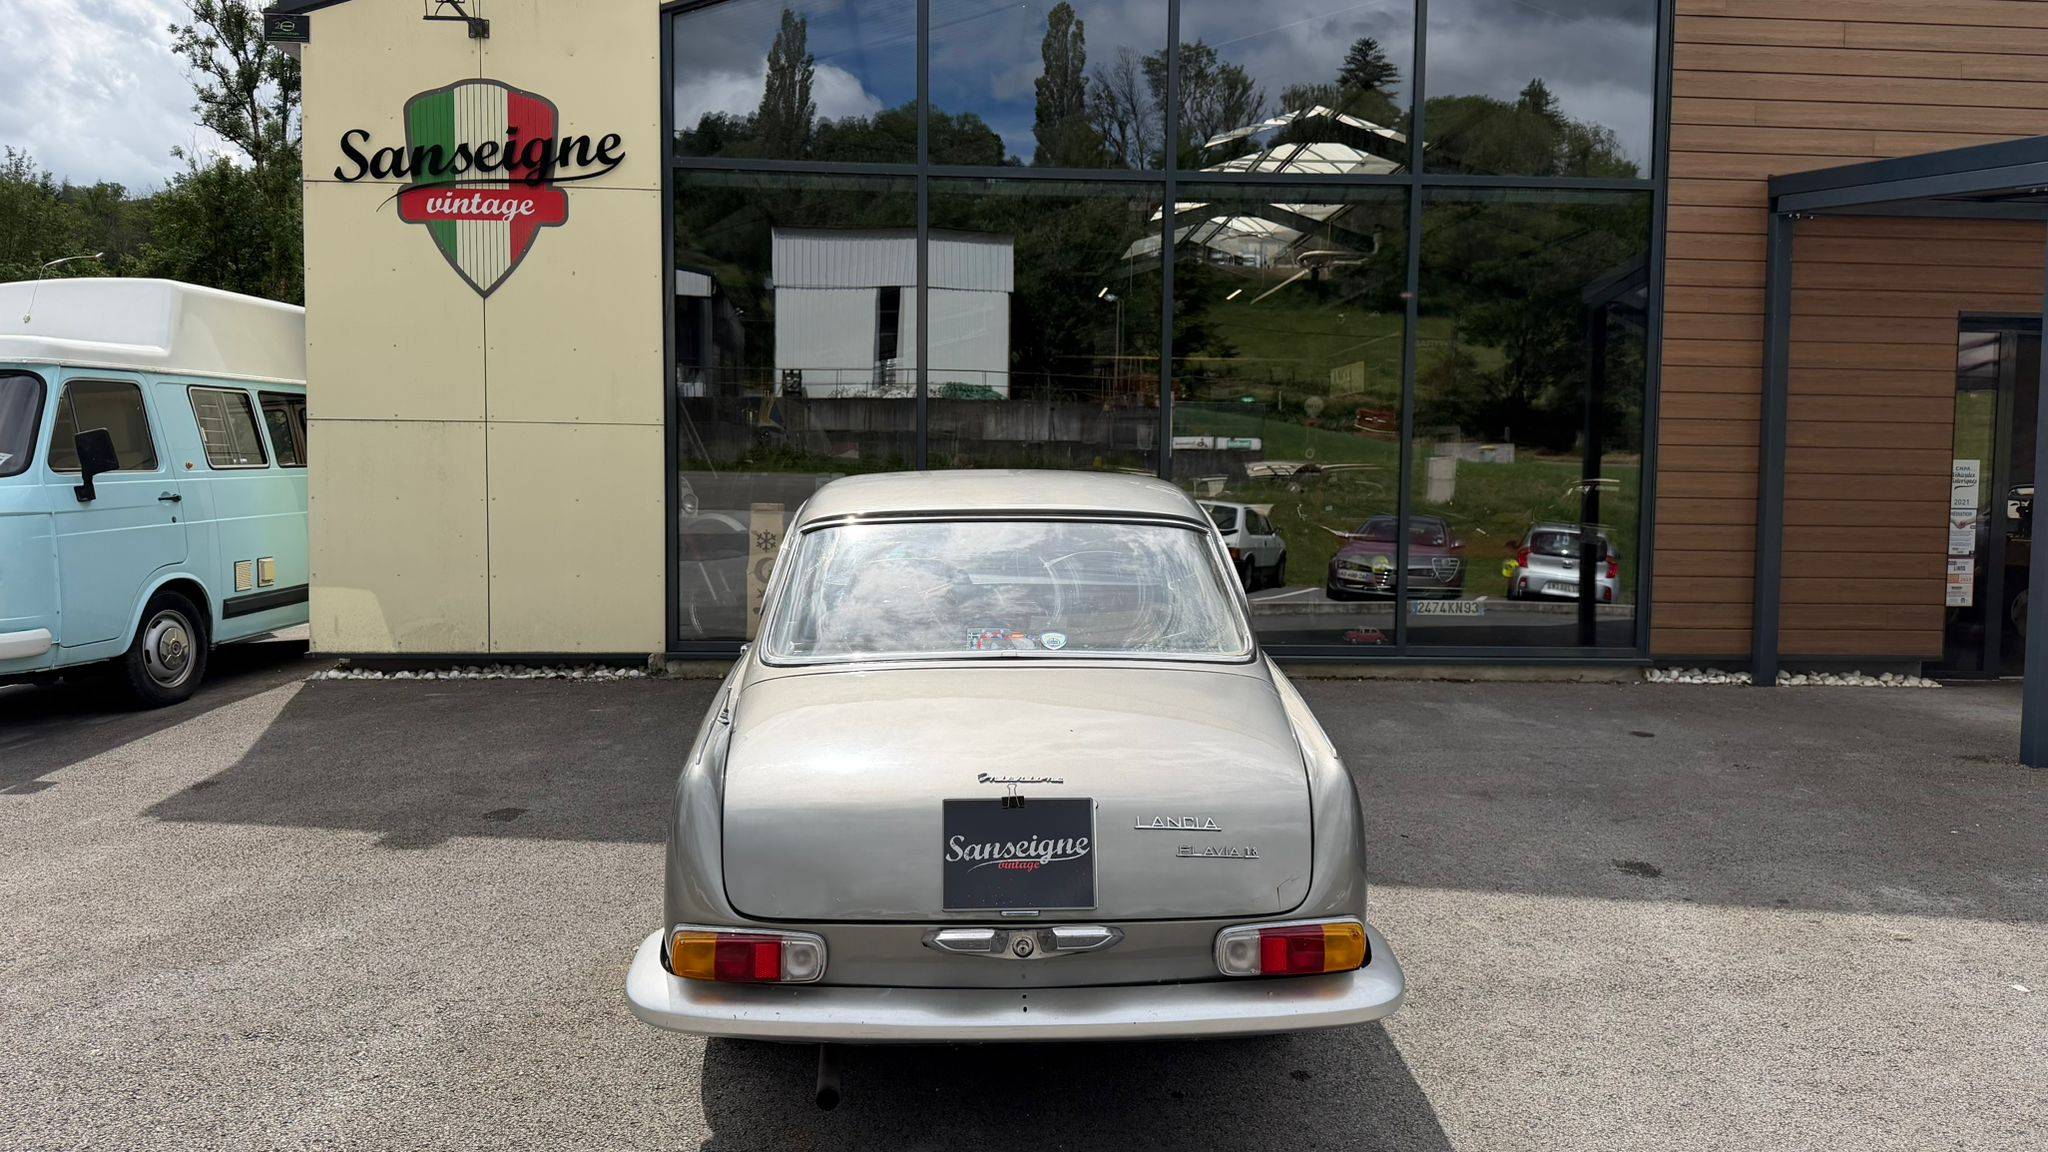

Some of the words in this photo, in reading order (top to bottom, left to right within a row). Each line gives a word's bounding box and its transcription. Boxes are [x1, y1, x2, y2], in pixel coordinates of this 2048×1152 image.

[333, 127, 626, 187] Sanseigne
[426, 191, 535, 222] vintage
[1954, 498, 1970, 506] 2021
[1418, 602, 1479, 614] 2474KN93
[1134, 816, 1222, 832] LANCIA
[945, 835, 1090, 865] Sanseigne
[998, 860, 1041, 873] vintage
